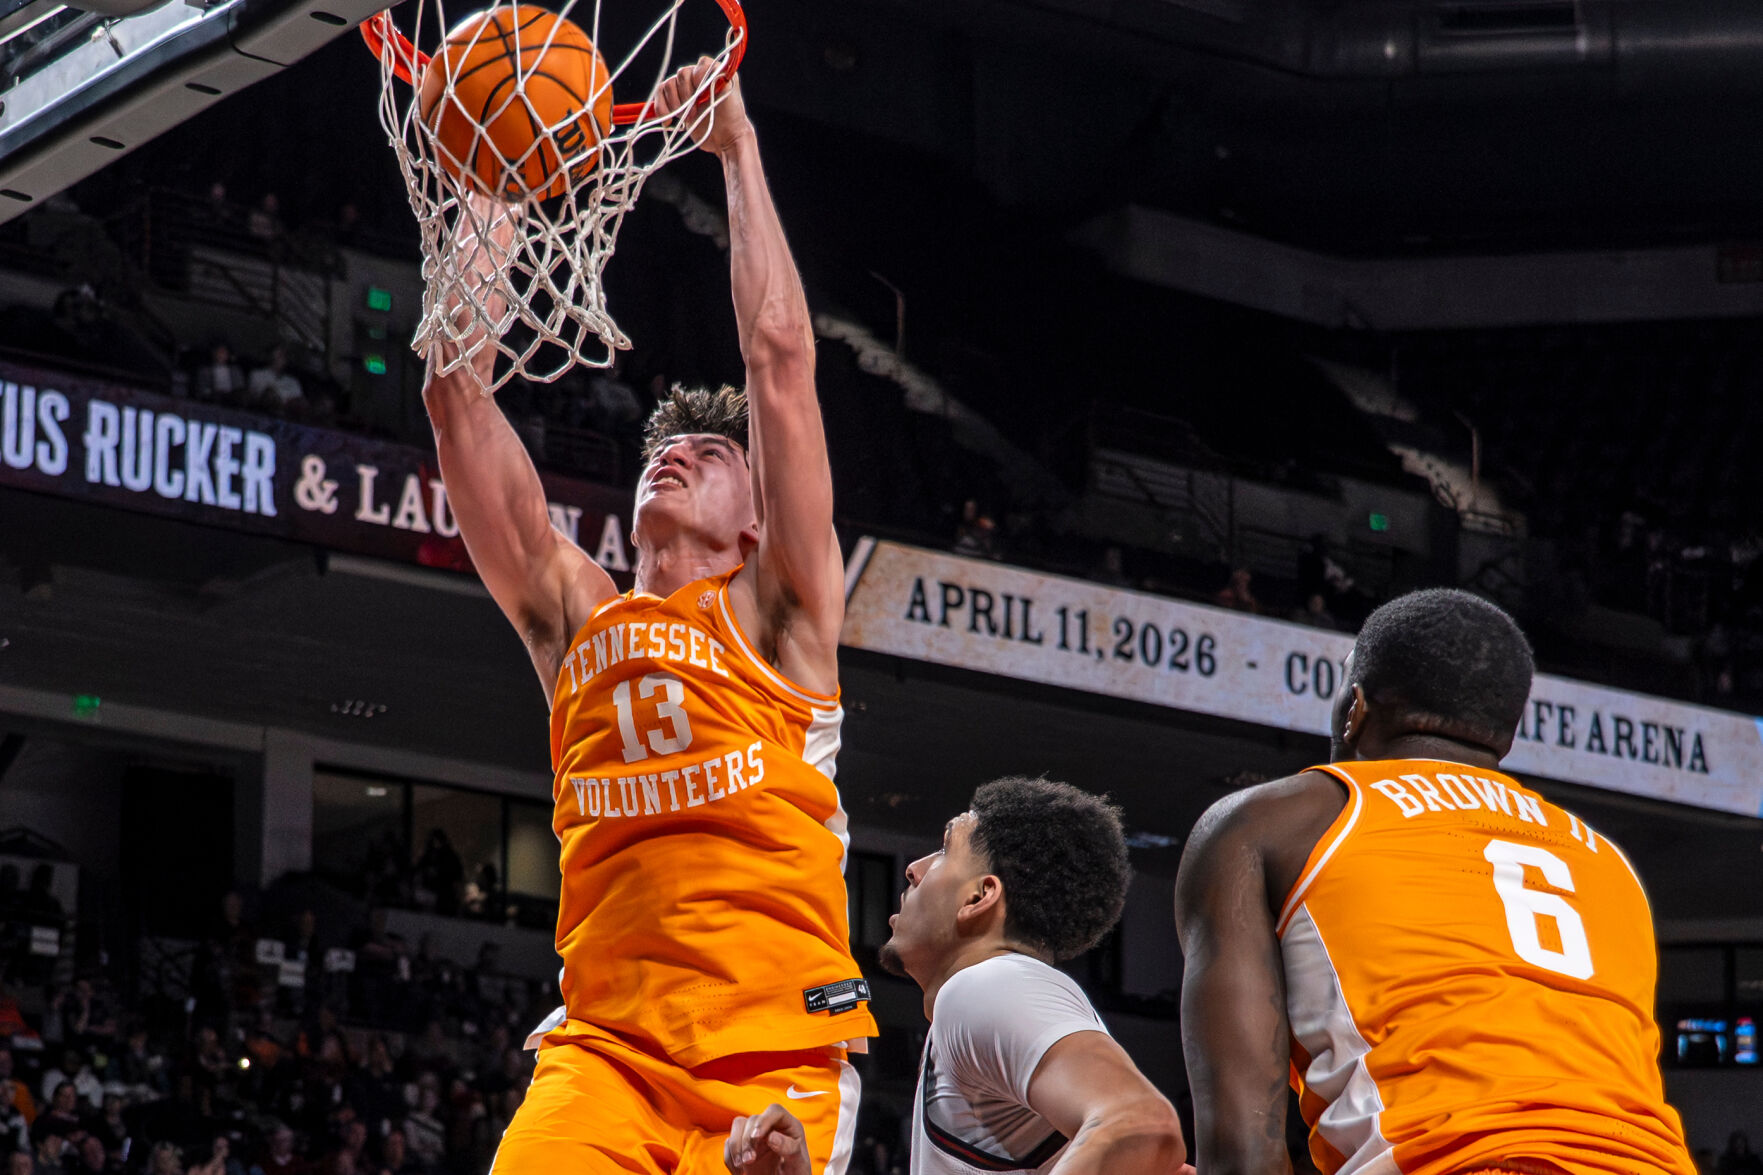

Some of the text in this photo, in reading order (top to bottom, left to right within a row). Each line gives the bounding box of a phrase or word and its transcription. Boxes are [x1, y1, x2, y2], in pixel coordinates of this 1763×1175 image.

[0, 379, 70, 476] US
[83, 399, 278, 517] RUCKER
[293, 454, 340, 514] &
[564, 622, 729, 694] TENNESSEE
[904, 576, 1043, 645] APRIL
[1585, 711, 1709, 774] ARENA
[613, 672, 693, 763] 13
[569, 741, 765, 817] VOLUNTEERS
[1370, 773, 1598, 854] BROWN II
[1484, 839, 1594, 980] 6
